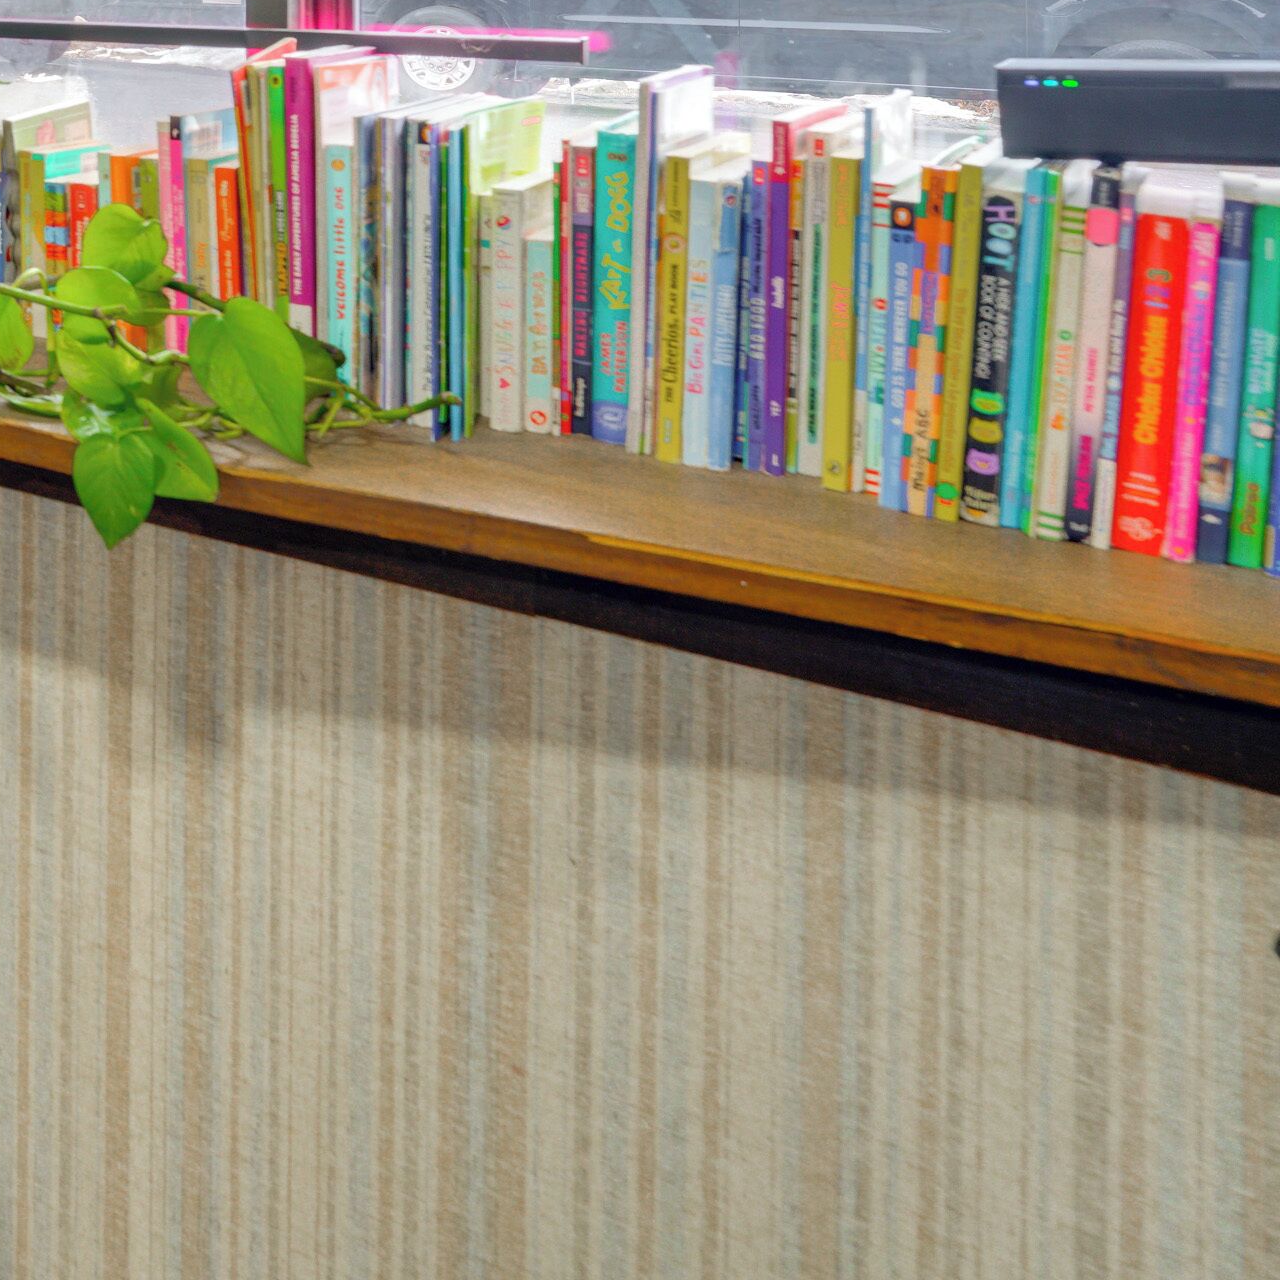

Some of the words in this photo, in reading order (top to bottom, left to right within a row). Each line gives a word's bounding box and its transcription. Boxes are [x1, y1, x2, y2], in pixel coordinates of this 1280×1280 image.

[289, 114, 299, 148] BEDELIA
[290, 151, 300, 180] AMELIA
[291, 182, 300, 194] OF
[604, 172, 631, 233] DOGG
[291, 195, 301, 248] ADVENTURES
[982, 205, 1017, 272] HOOT
[277, 242, 287, 294] TRAPPED
[292, 250, 302, 277] EARLY
[670, 264, 679, 290] BOOK
[895, 261, 909, 277] GO
[293, 280, 302, 295] THE
[894, 279, 908, 297] YOU
[979, 274, 998, 304] BOOK
[996, 276, 1012, 287] A
[668, 293, 678, 315] PLAY
[689, 259, 708, 337] PANTIES
[995, 288, 1011, 312] HIDE
[893, 300, 908, 343] WHEREVER
[978, 305, 997, 321] OF
[993, 313, 1009, 336] AND
[496, 301, 514, 374] SNUGGE
[712, 337, 735, 366] POTTY
[1140, 315, 1168, 378] Chicka
[599, 332, 611, 375] JAMES
[614, 321, 627, 393] PATTERSON
[661, 322, 678, 383] Cheerios
[892, 346, 907, 372] THERE
[665, 386, 673, 403] THE
[891, 375, 905, 387] IS
[891, 388, 905, 409] GOD
[915, 409, 930, 437] ABC
[1133, 382, 1162, 445] Chicka
